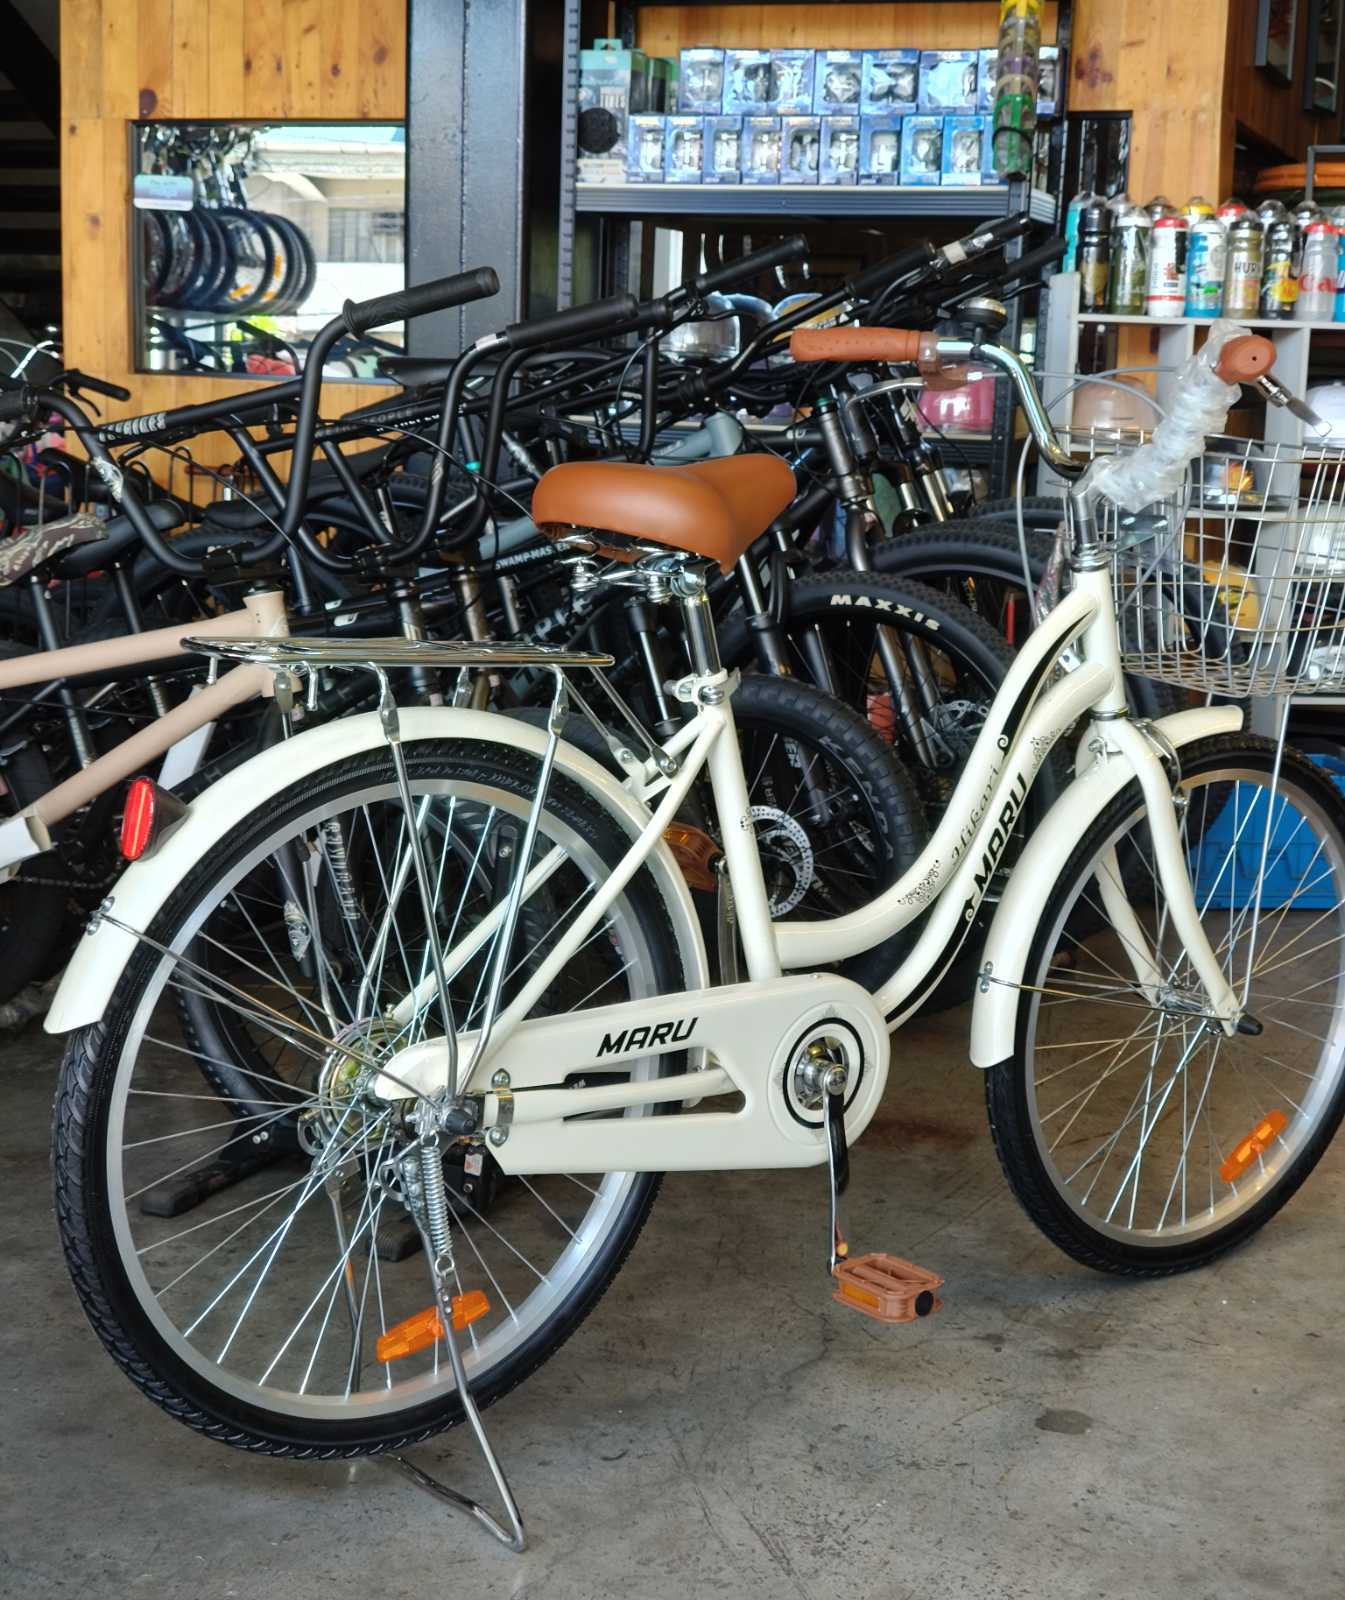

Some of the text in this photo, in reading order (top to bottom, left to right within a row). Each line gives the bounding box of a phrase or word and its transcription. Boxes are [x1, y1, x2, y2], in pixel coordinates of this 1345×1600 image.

[830, 594, 940, 631] MAXXIS
[973, 771, 1028, 895] MARU
[596, 1016, 699, 1058] MARU
